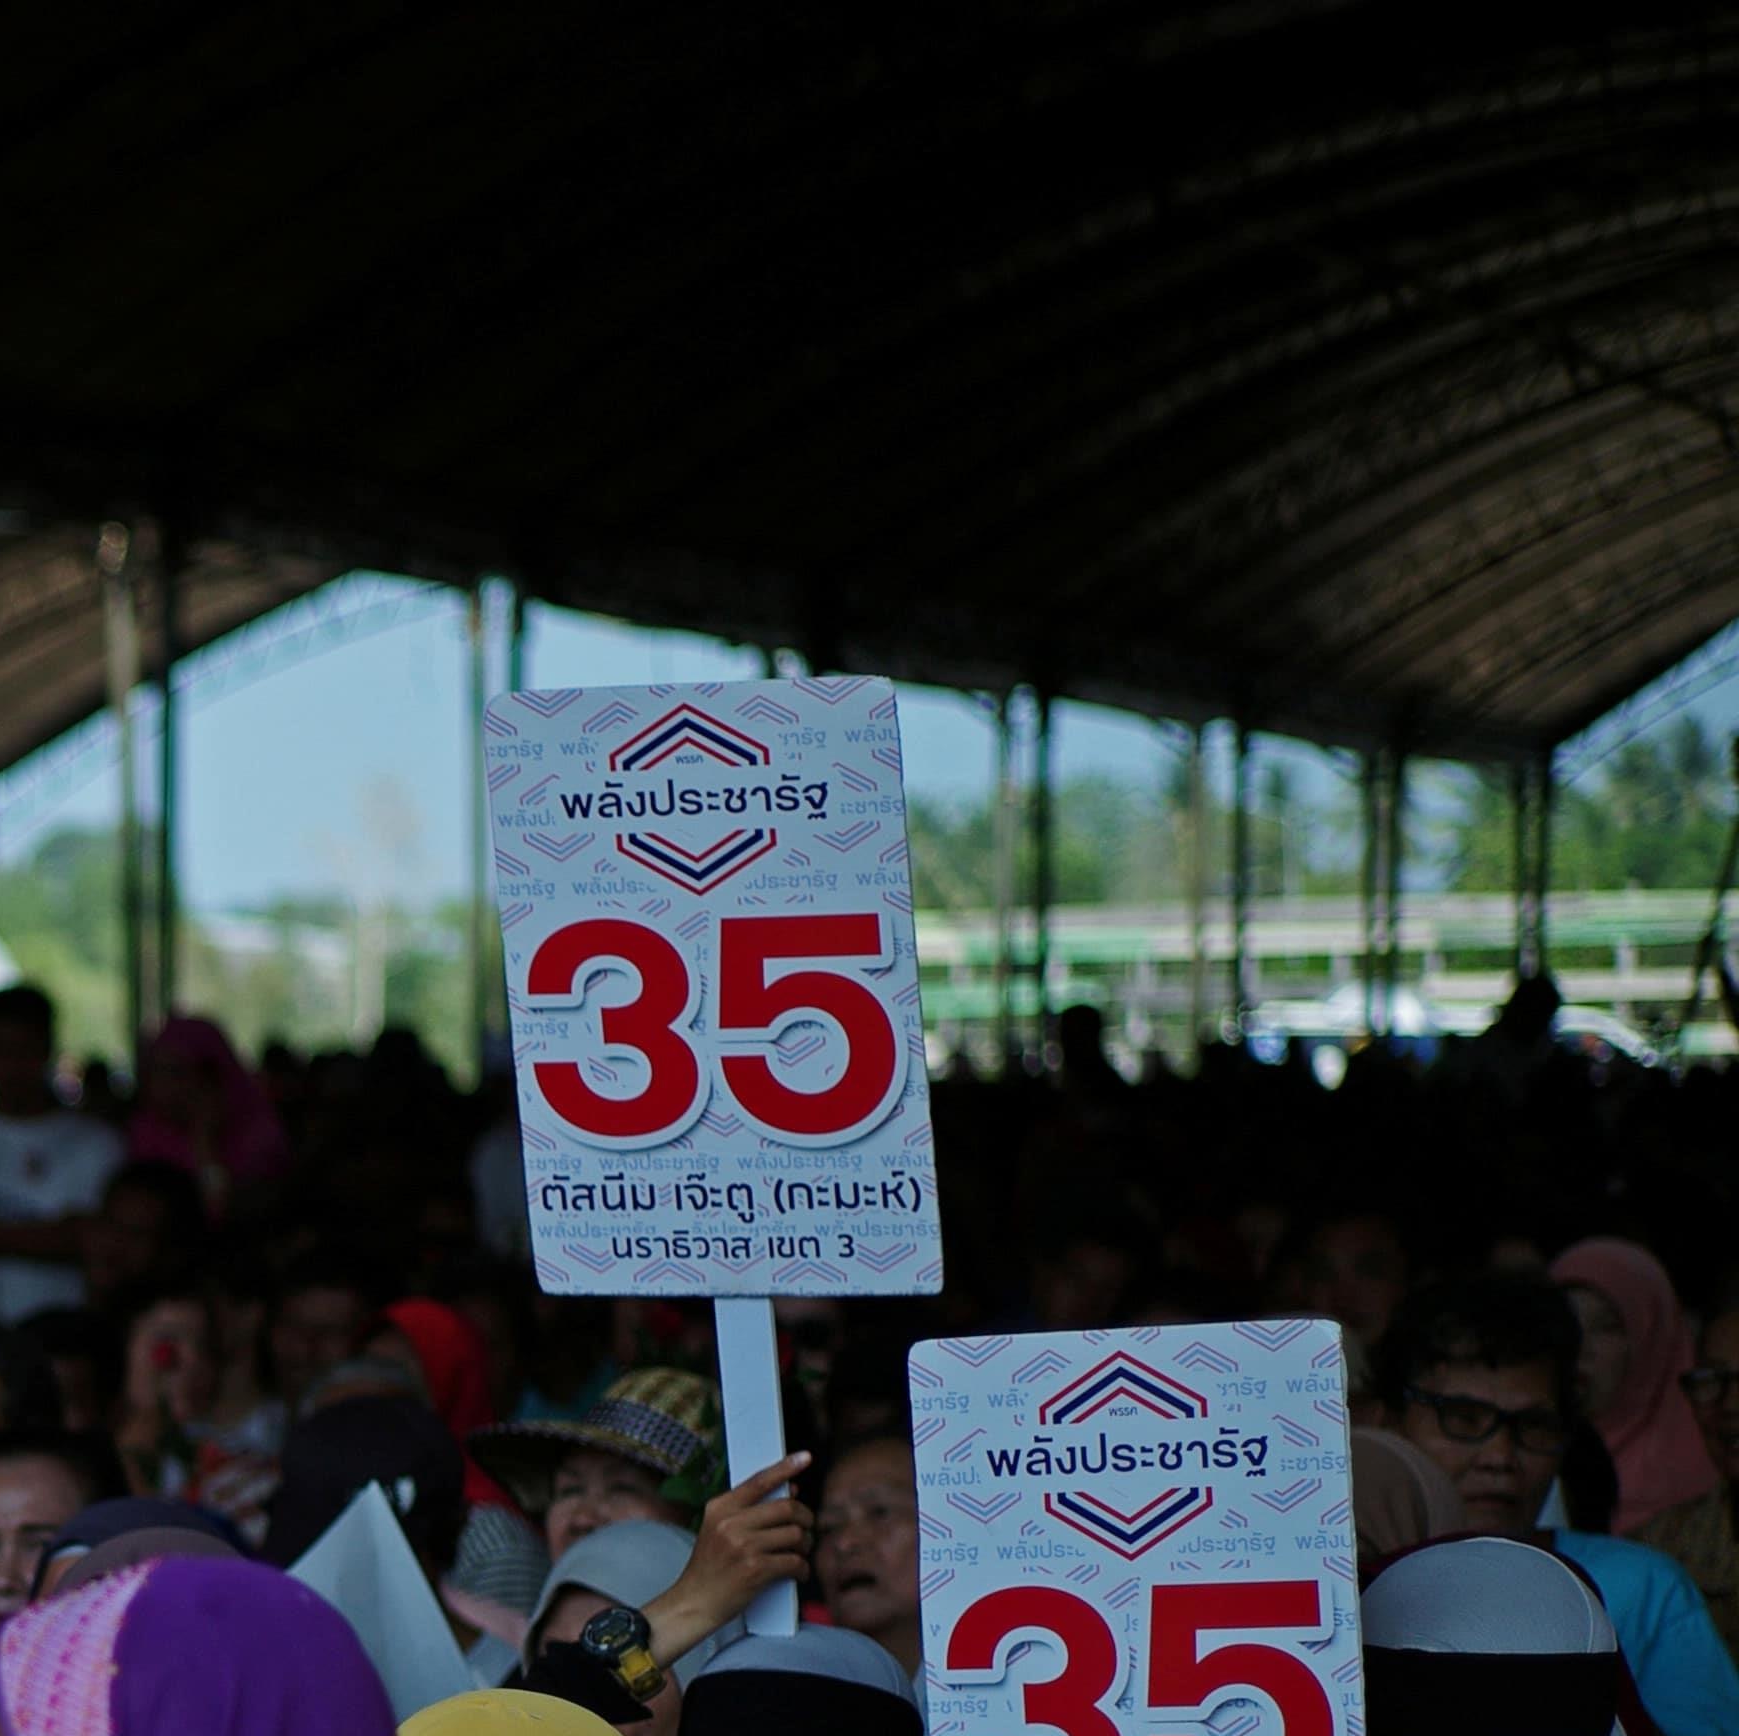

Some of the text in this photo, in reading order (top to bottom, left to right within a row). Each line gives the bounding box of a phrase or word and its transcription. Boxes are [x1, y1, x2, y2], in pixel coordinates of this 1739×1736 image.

[561, 775, 828, 819] พลังประชารัฐ
[528, 913, 896, 1137] 35
[542, 1174, 656, 1212] ตัสนีม
[675, 1173, 755, 1224] เจ๊ะตู
[612, 1230, 854, 1259] นราธิวาส เขต 3
[1108, 1406, 1138, 1417] พรรค
[987, 1428, 1268, 1477] พลังประชารัฐ
